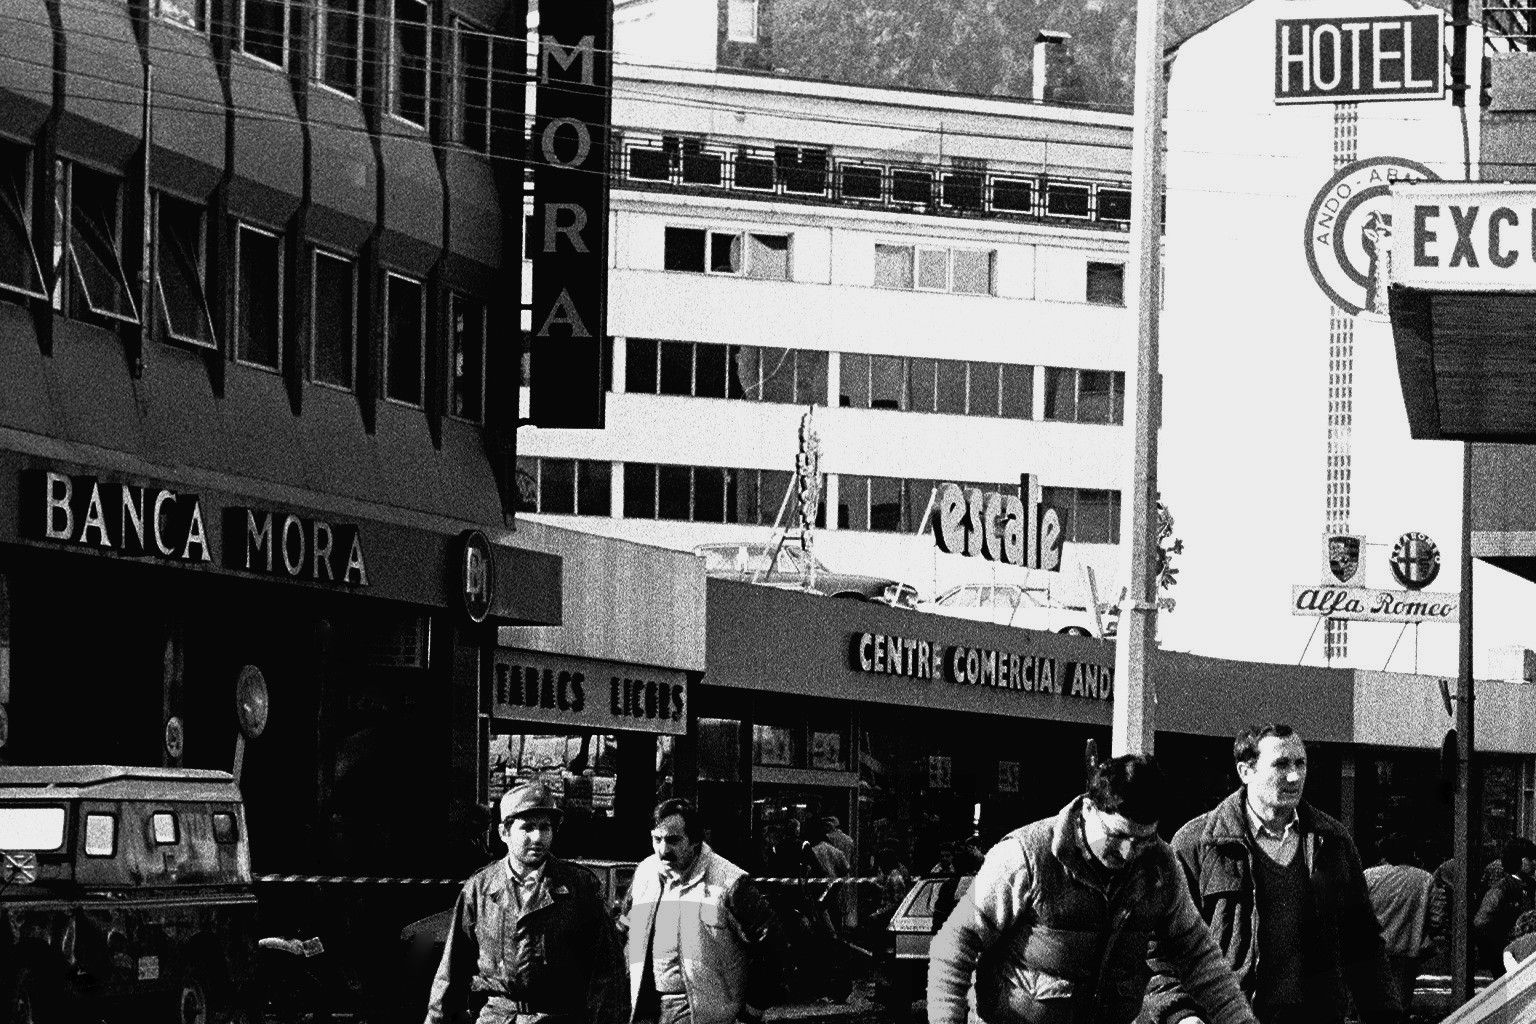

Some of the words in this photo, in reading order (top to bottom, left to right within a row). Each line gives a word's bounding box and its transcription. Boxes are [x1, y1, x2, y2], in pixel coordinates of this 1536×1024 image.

[1281, 24, 1433, 92] HOTEL
[537, 34, 595, 338] MORA
[45, 471, 211, 562] BANCA
[246, 508, 370, 586] MORA
[935, 473, 1062, 573] escale
[1296, 589, 1364, 616] Alfa
[1371, 592, 1457, 618] Romeo
[495, 662, 586, 712] TABACS
[859, 632, 942, 680] CENTRE
[953, 647, 1063, 694] COMERCIAL
